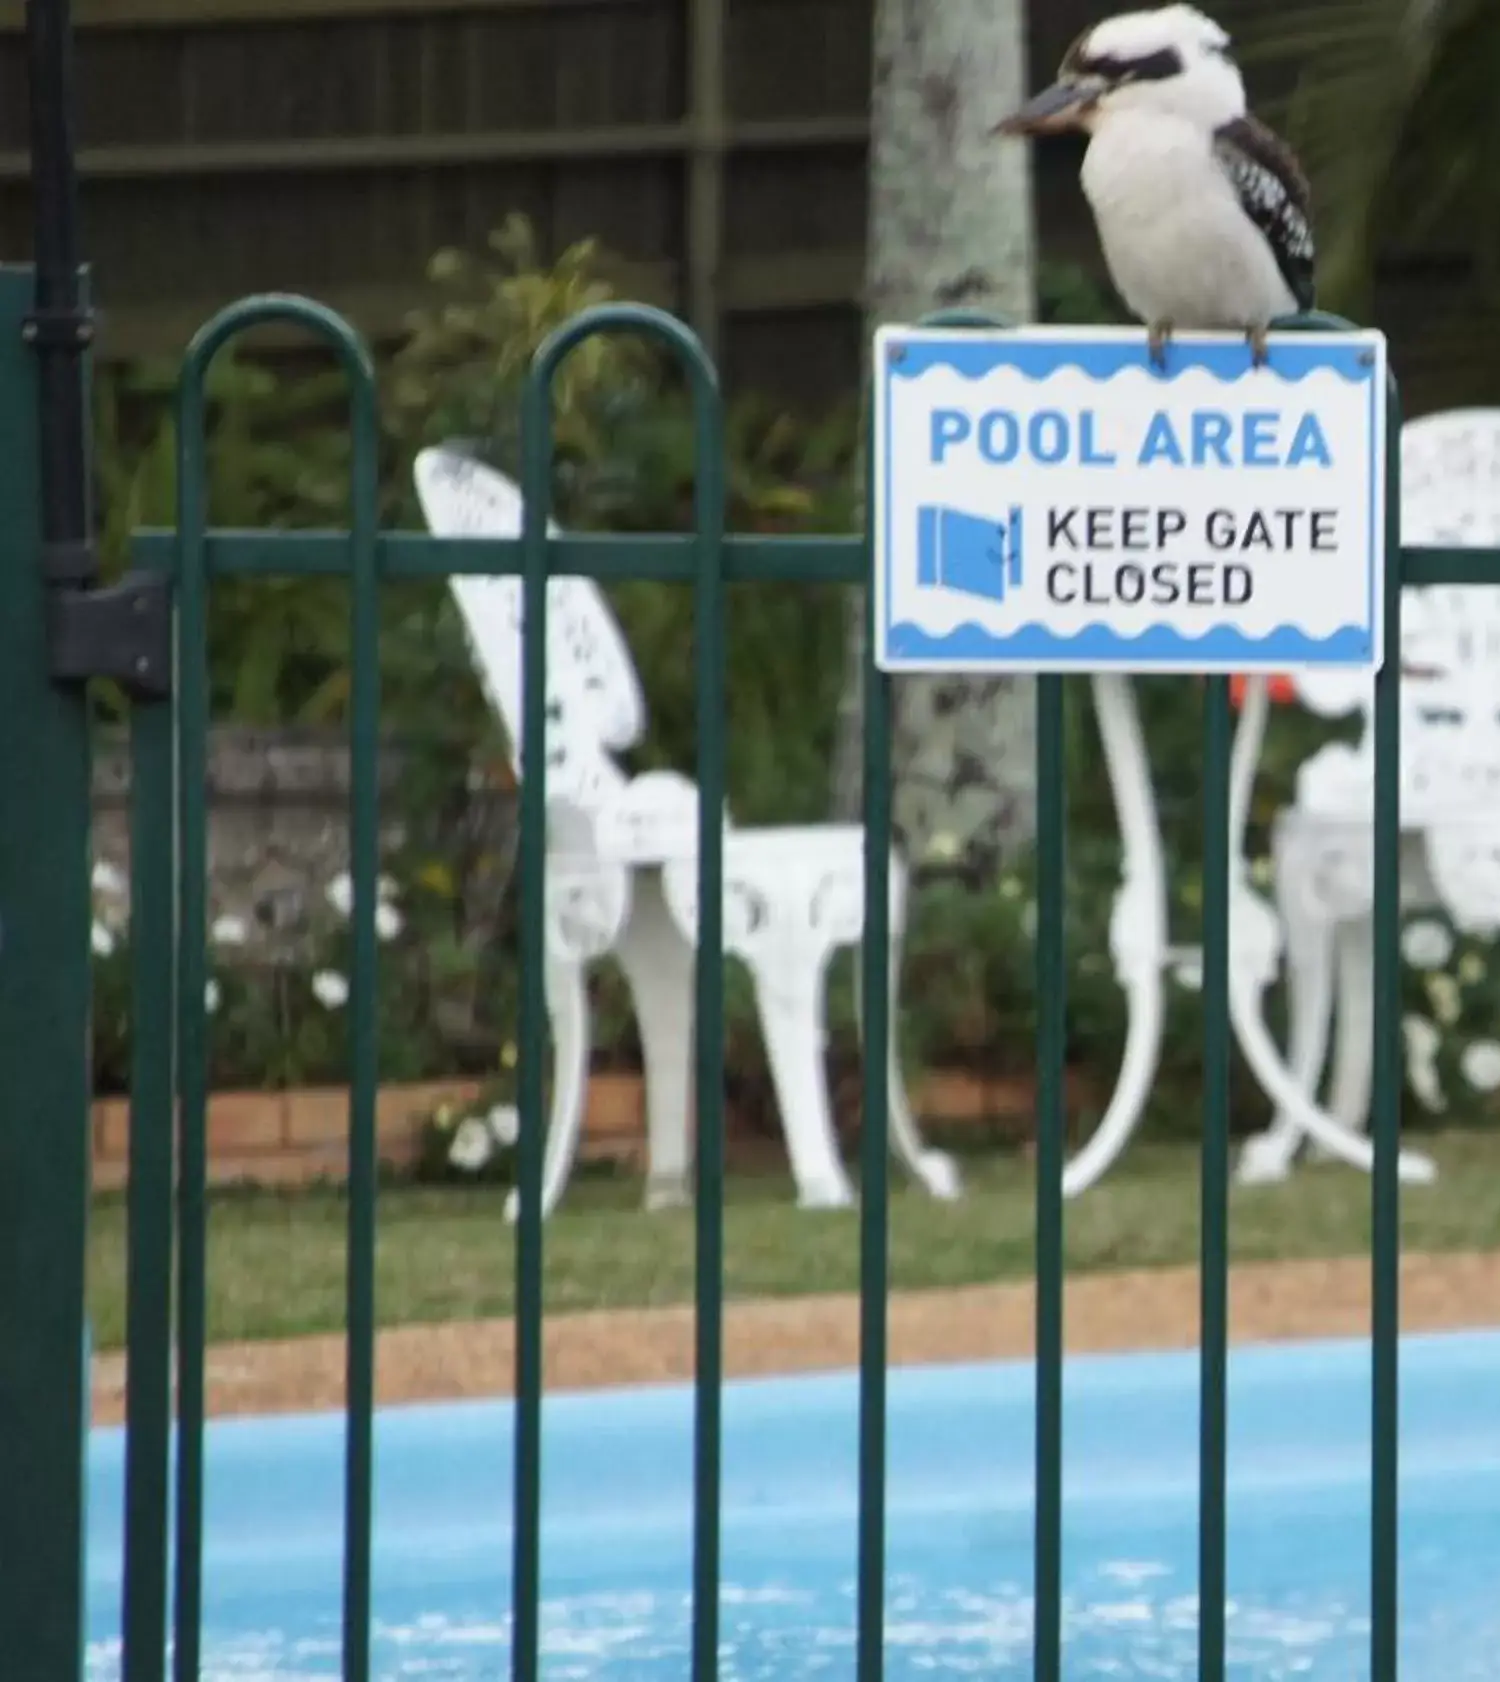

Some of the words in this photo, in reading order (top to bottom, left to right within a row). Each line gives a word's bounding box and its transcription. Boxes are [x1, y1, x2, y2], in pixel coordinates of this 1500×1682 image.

[931, 410, 1116, 466] POOL
[1138, 410, 1333, 467] AREA
[1048, 507, 1187, 552] KEEP
[1205, 508, 1338, 552] GATE
[1046, 563, 1253, 605] CLOSED
